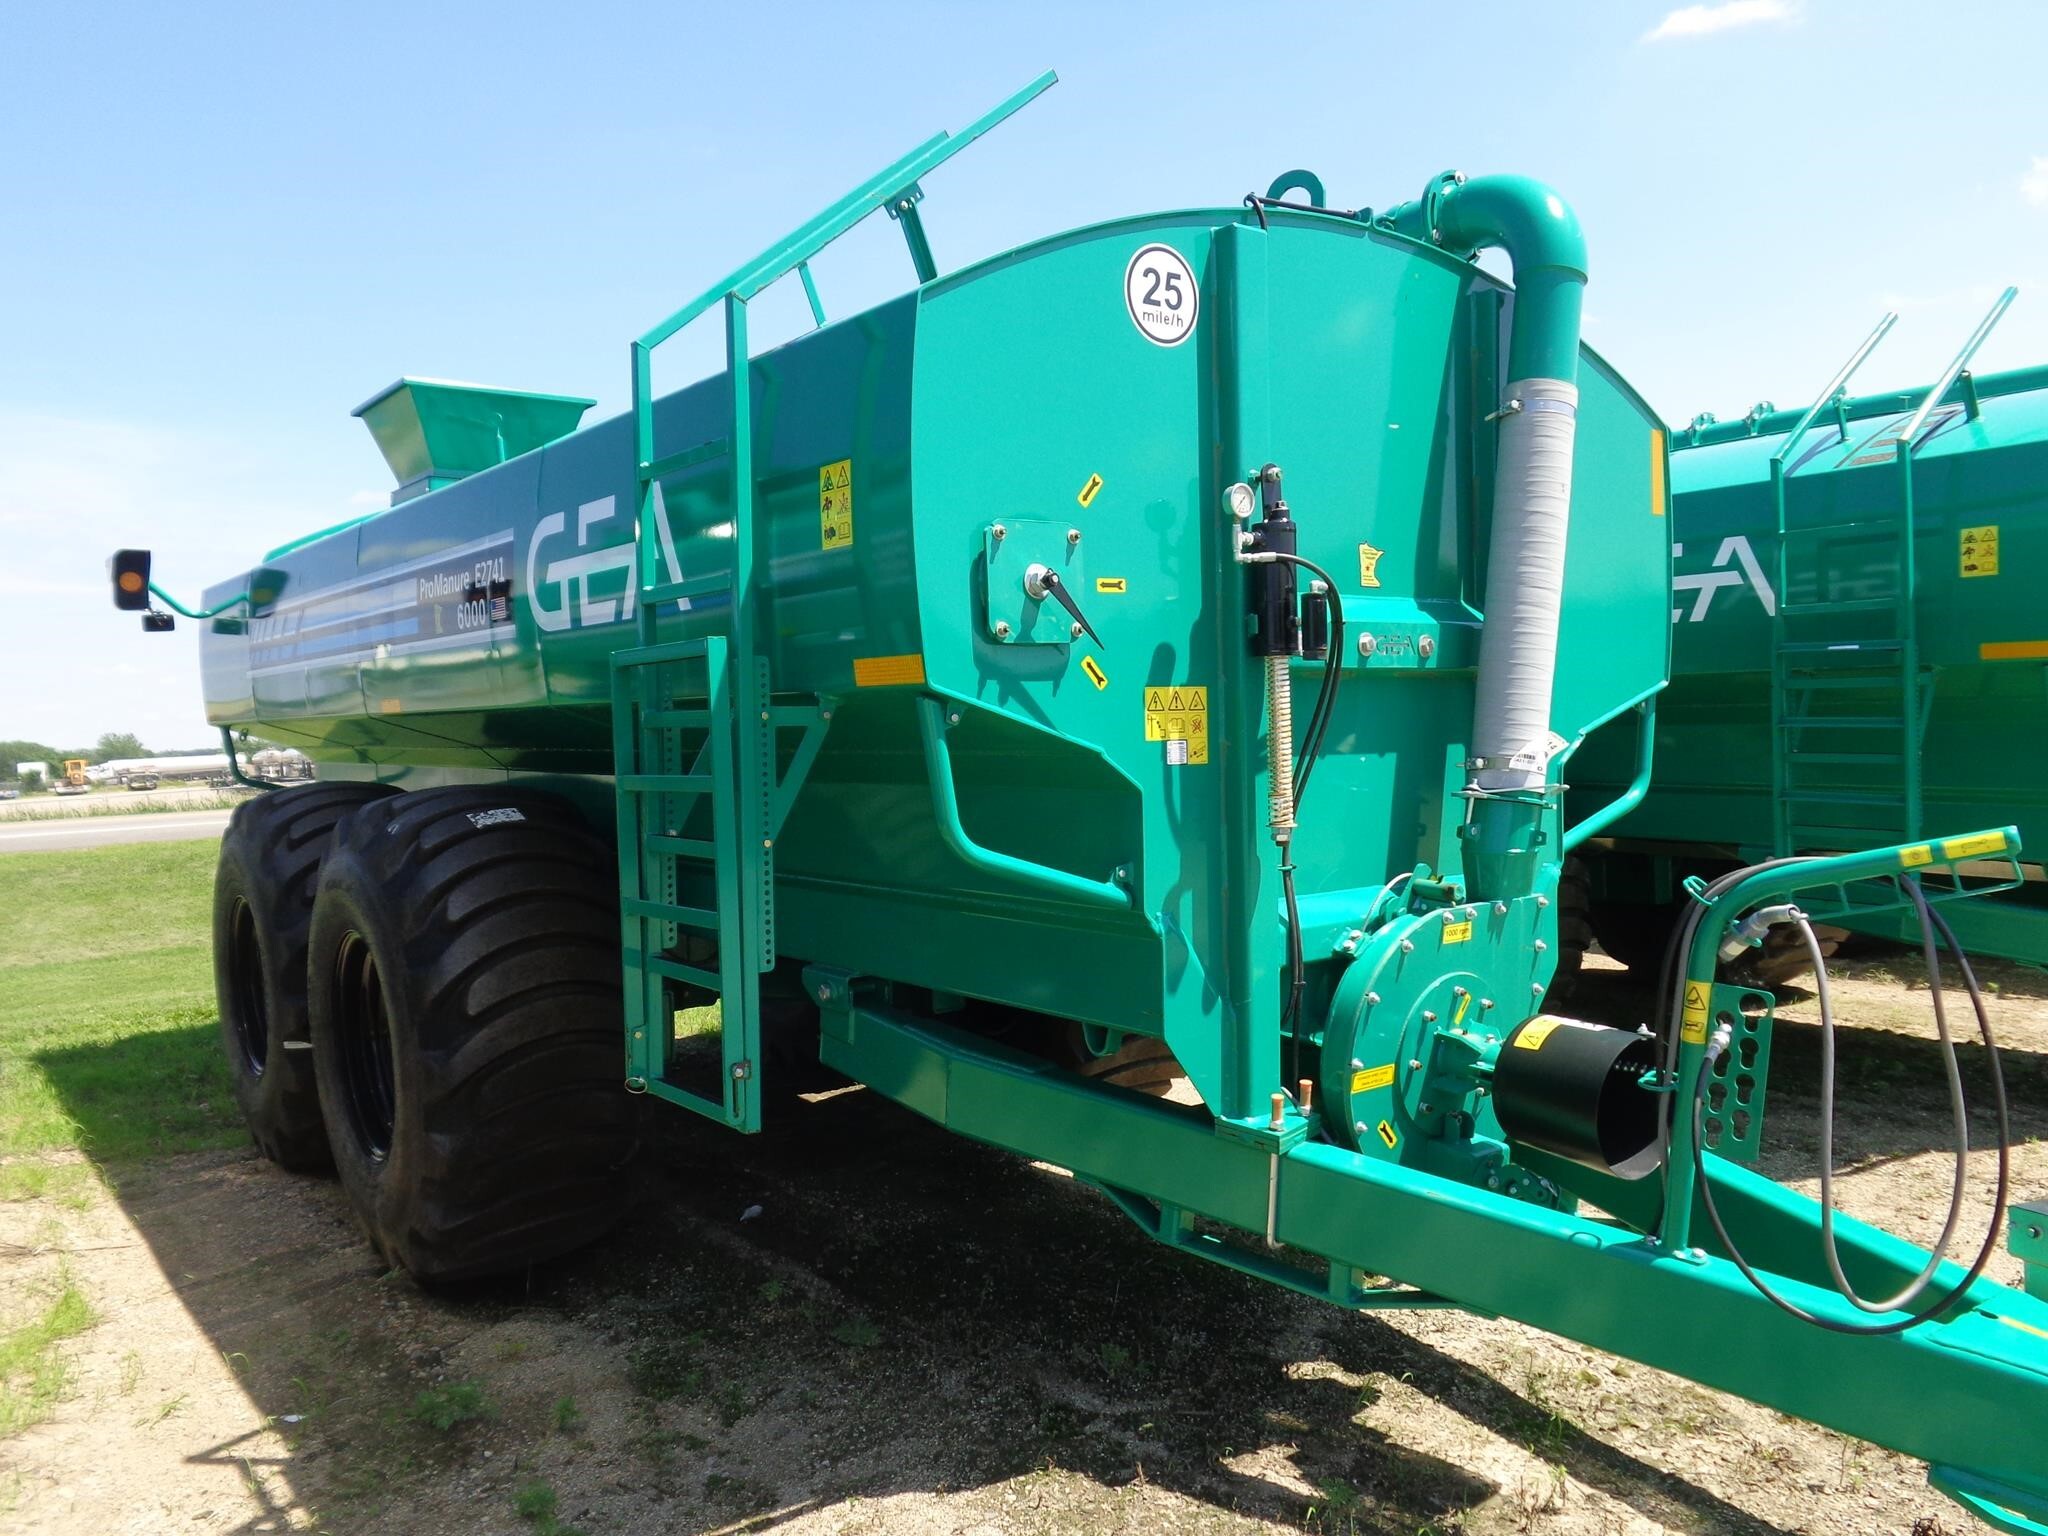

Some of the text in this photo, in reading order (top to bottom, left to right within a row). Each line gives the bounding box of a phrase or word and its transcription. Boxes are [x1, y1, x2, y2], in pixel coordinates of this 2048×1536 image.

[1142, 267, 1182, 311] 25
[1142, 310, 1184, 328] mile/h
[526, 480, 692, 632] GEA
[420, 557, 505, 600] ProManure E2741
[457, 598, 486, 630] 6000
[1376, 634, 1416, 656] GEA
